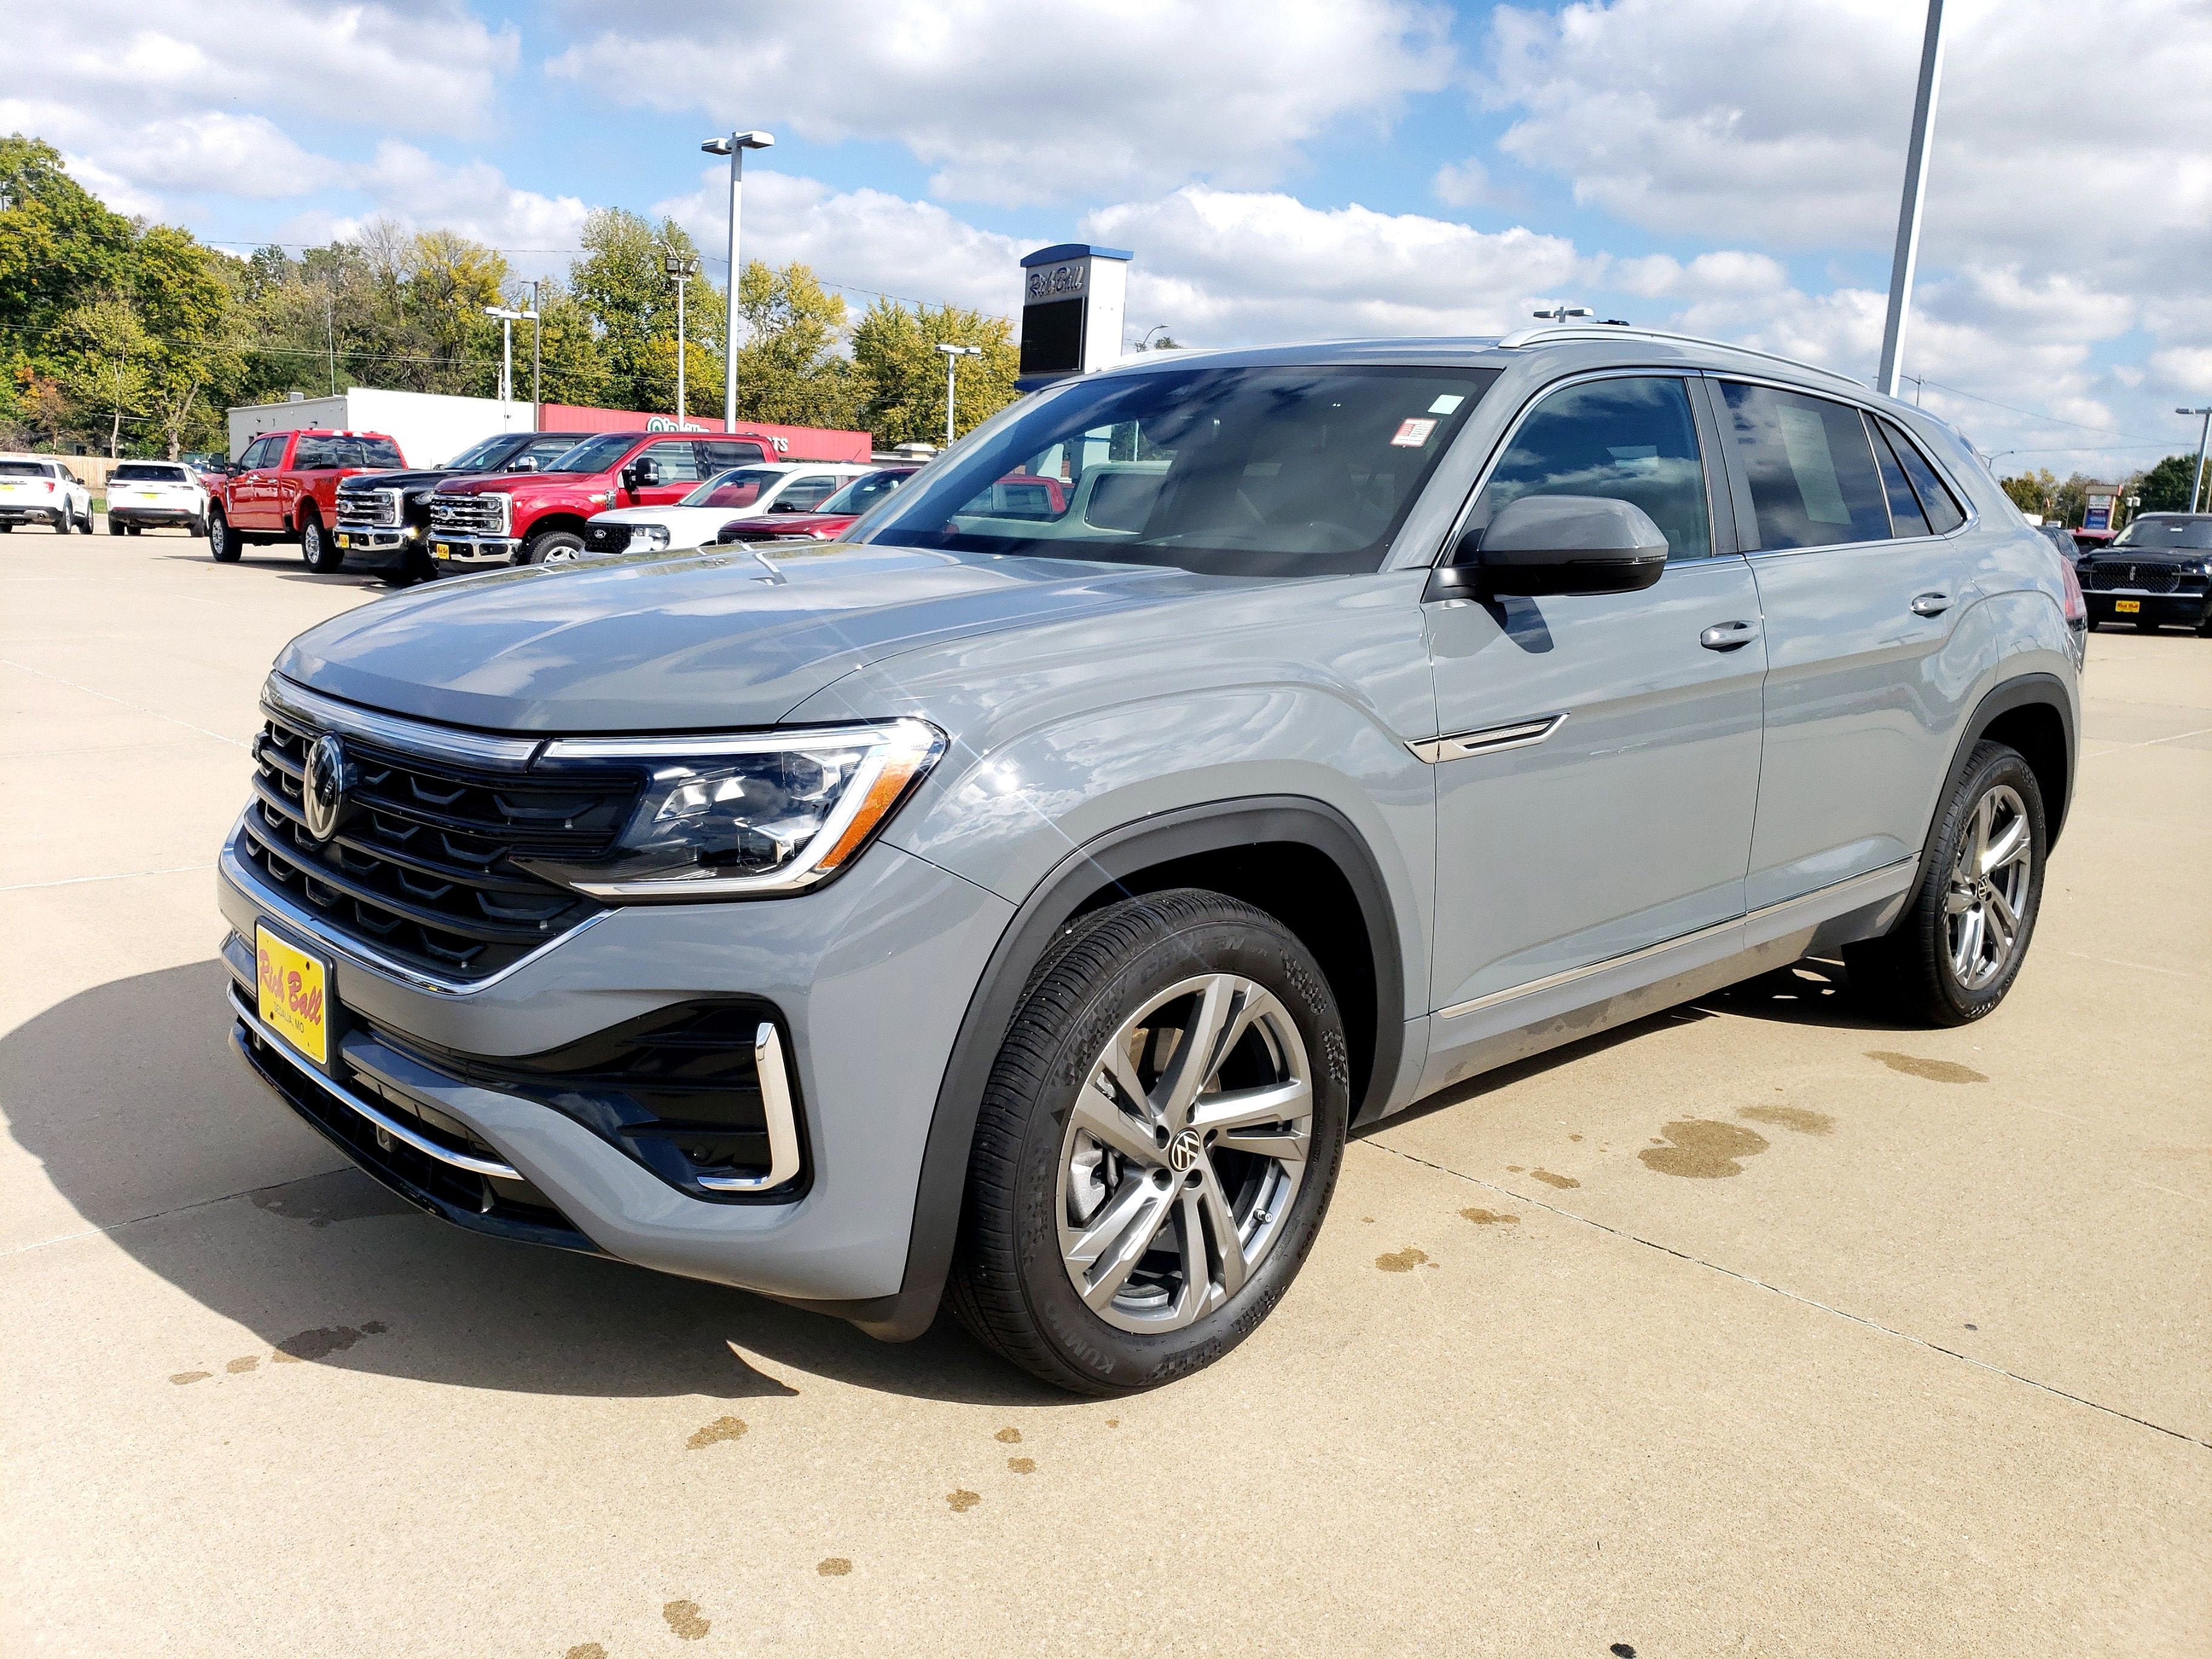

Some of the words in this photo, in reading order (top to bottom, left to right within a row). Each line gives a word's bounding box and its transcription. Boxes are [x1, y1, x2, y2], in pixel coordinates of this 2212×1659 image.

[259, 949, 285, 1003] Rick
[287, 971, 322, 1025] Ball
[295, 1020, 304, 1033] MO
